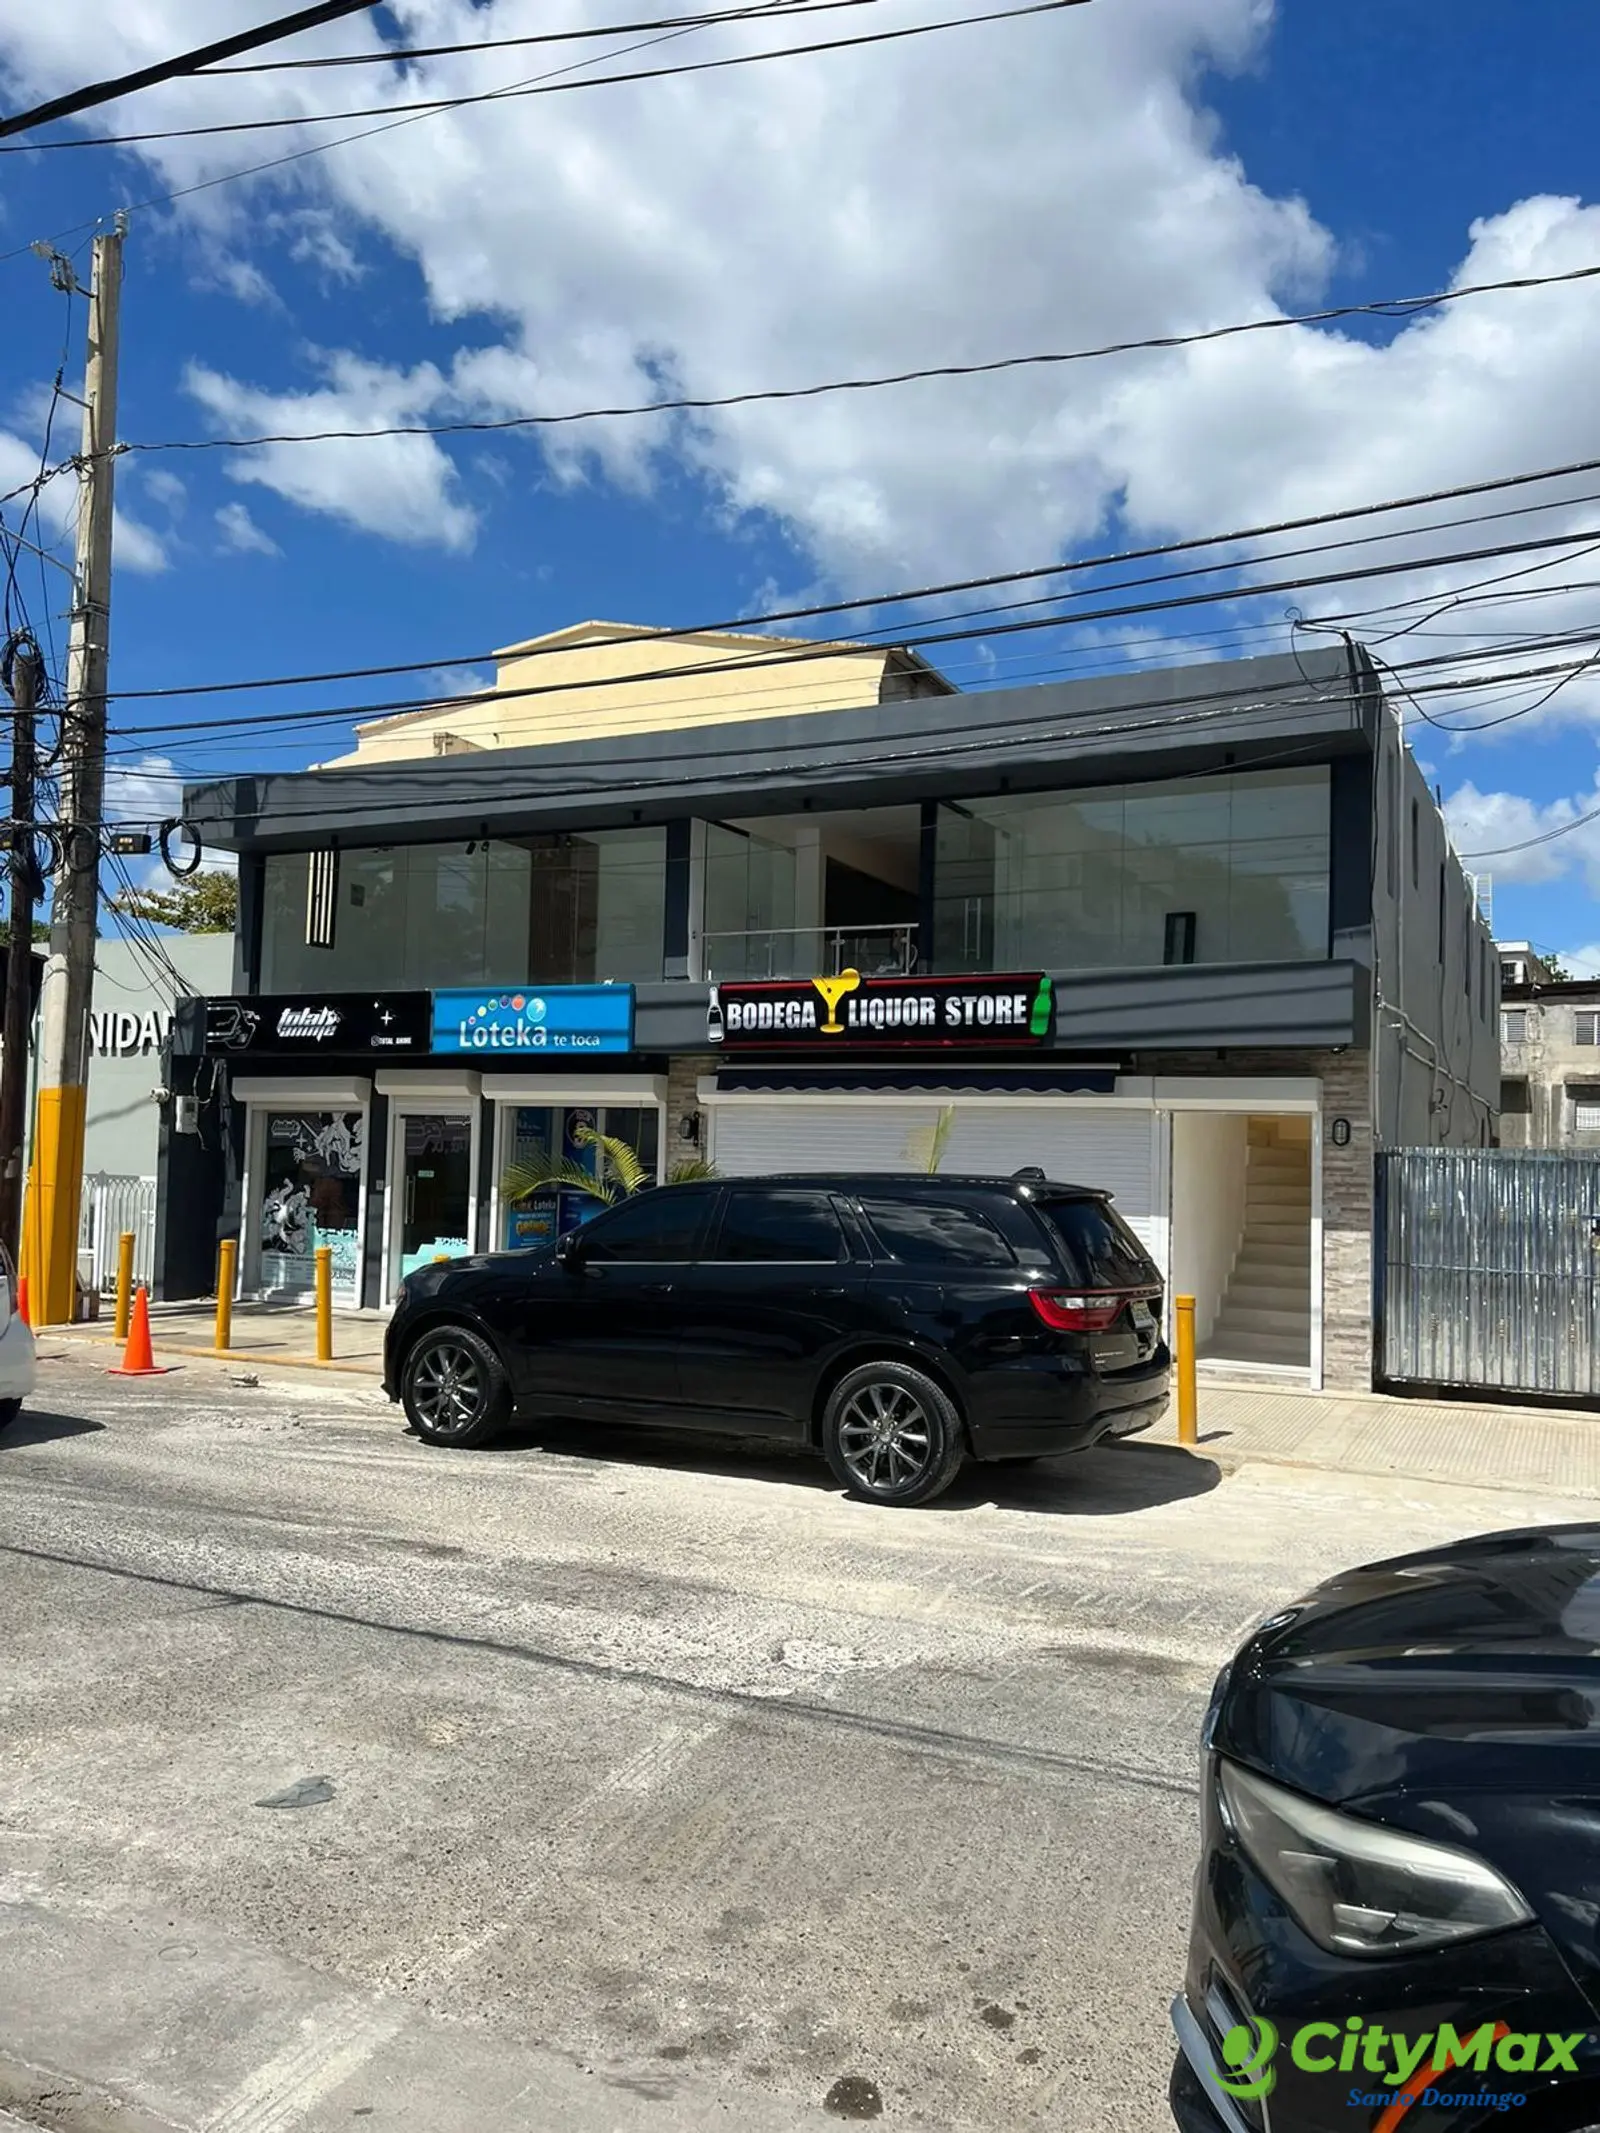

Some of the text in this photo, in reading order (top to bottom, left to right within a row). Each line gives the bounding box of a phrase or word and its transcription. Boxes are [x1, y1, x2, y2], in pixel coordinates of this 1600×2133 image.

[726, 995, 1027, 1030] BODEGA LIQUOR STORE
[459, 1018, 600, 1047] Loteka te toca
